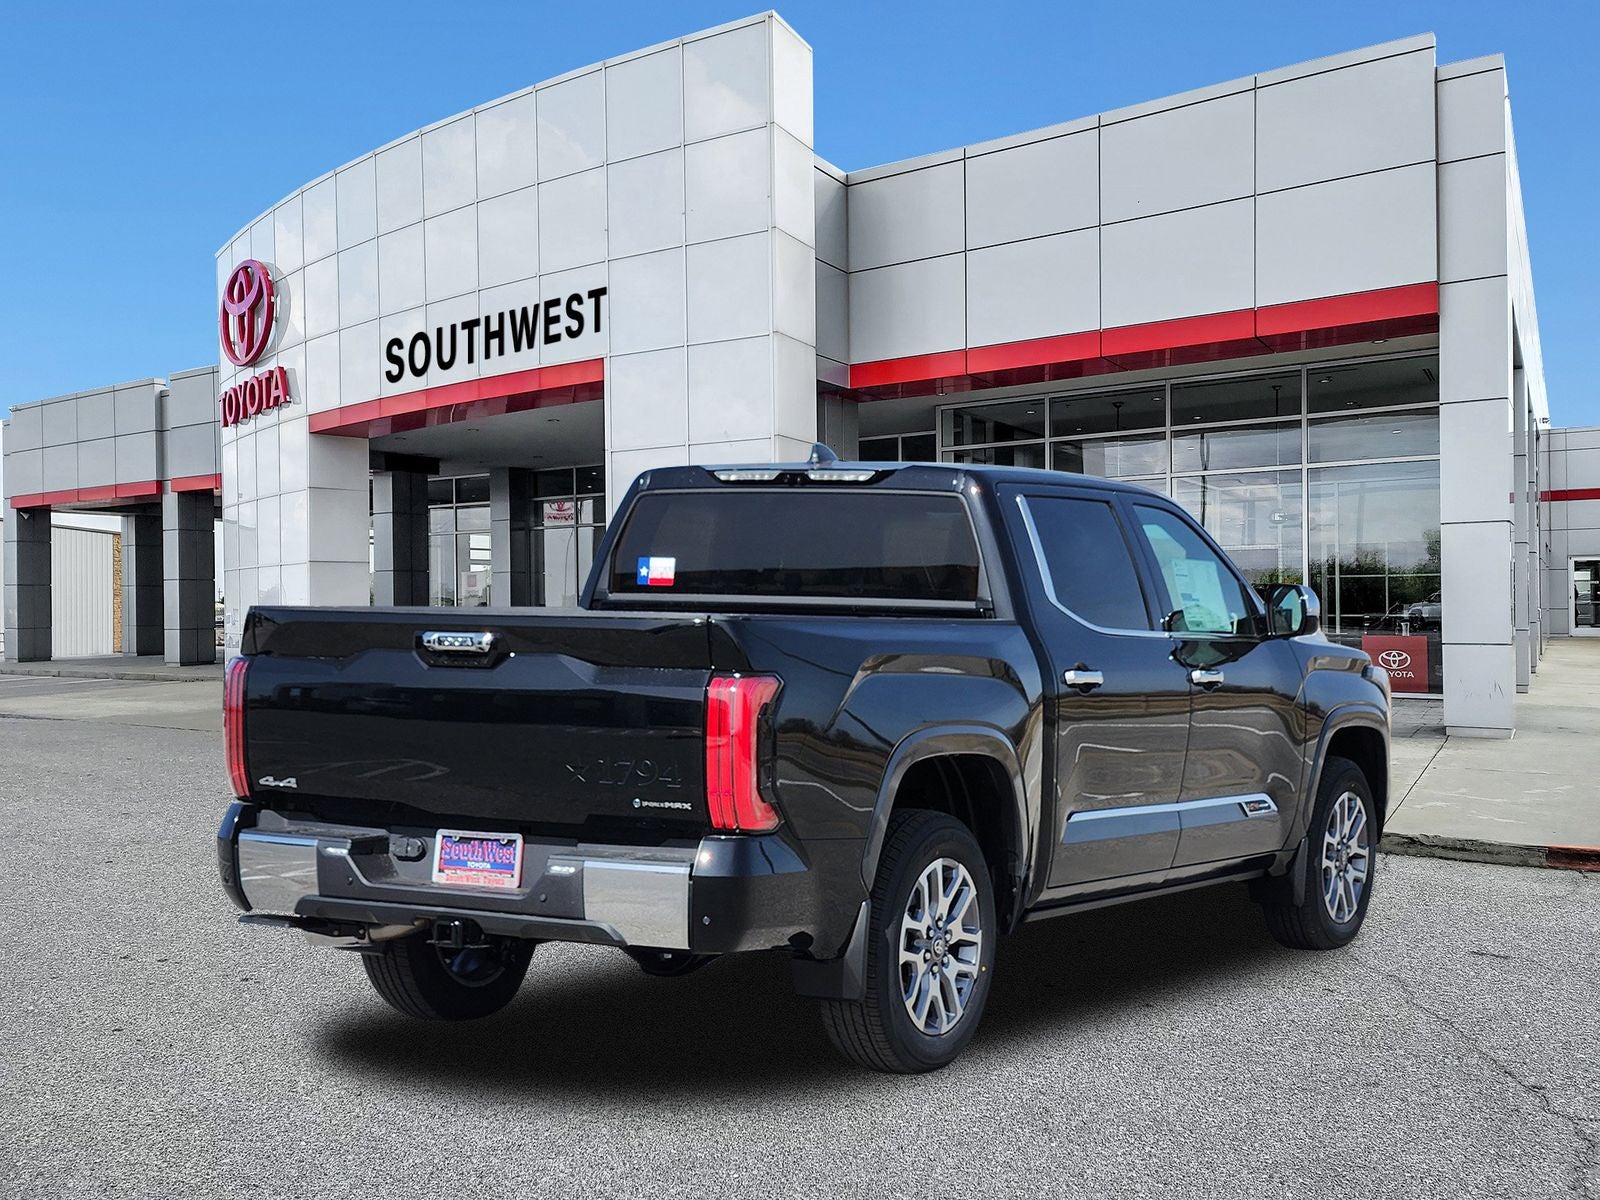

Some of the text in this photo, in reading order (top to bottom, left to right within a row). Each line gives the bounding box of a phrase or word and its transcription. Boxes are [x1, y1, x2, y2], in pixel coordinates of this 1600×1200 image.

[385, 287, 608, 384] SOUTHWEST
[218, 366, 290, 428] TOYOTA
[598, 759, 682, 788] 1794
[467, 860, 491, 869] TOYOTA
